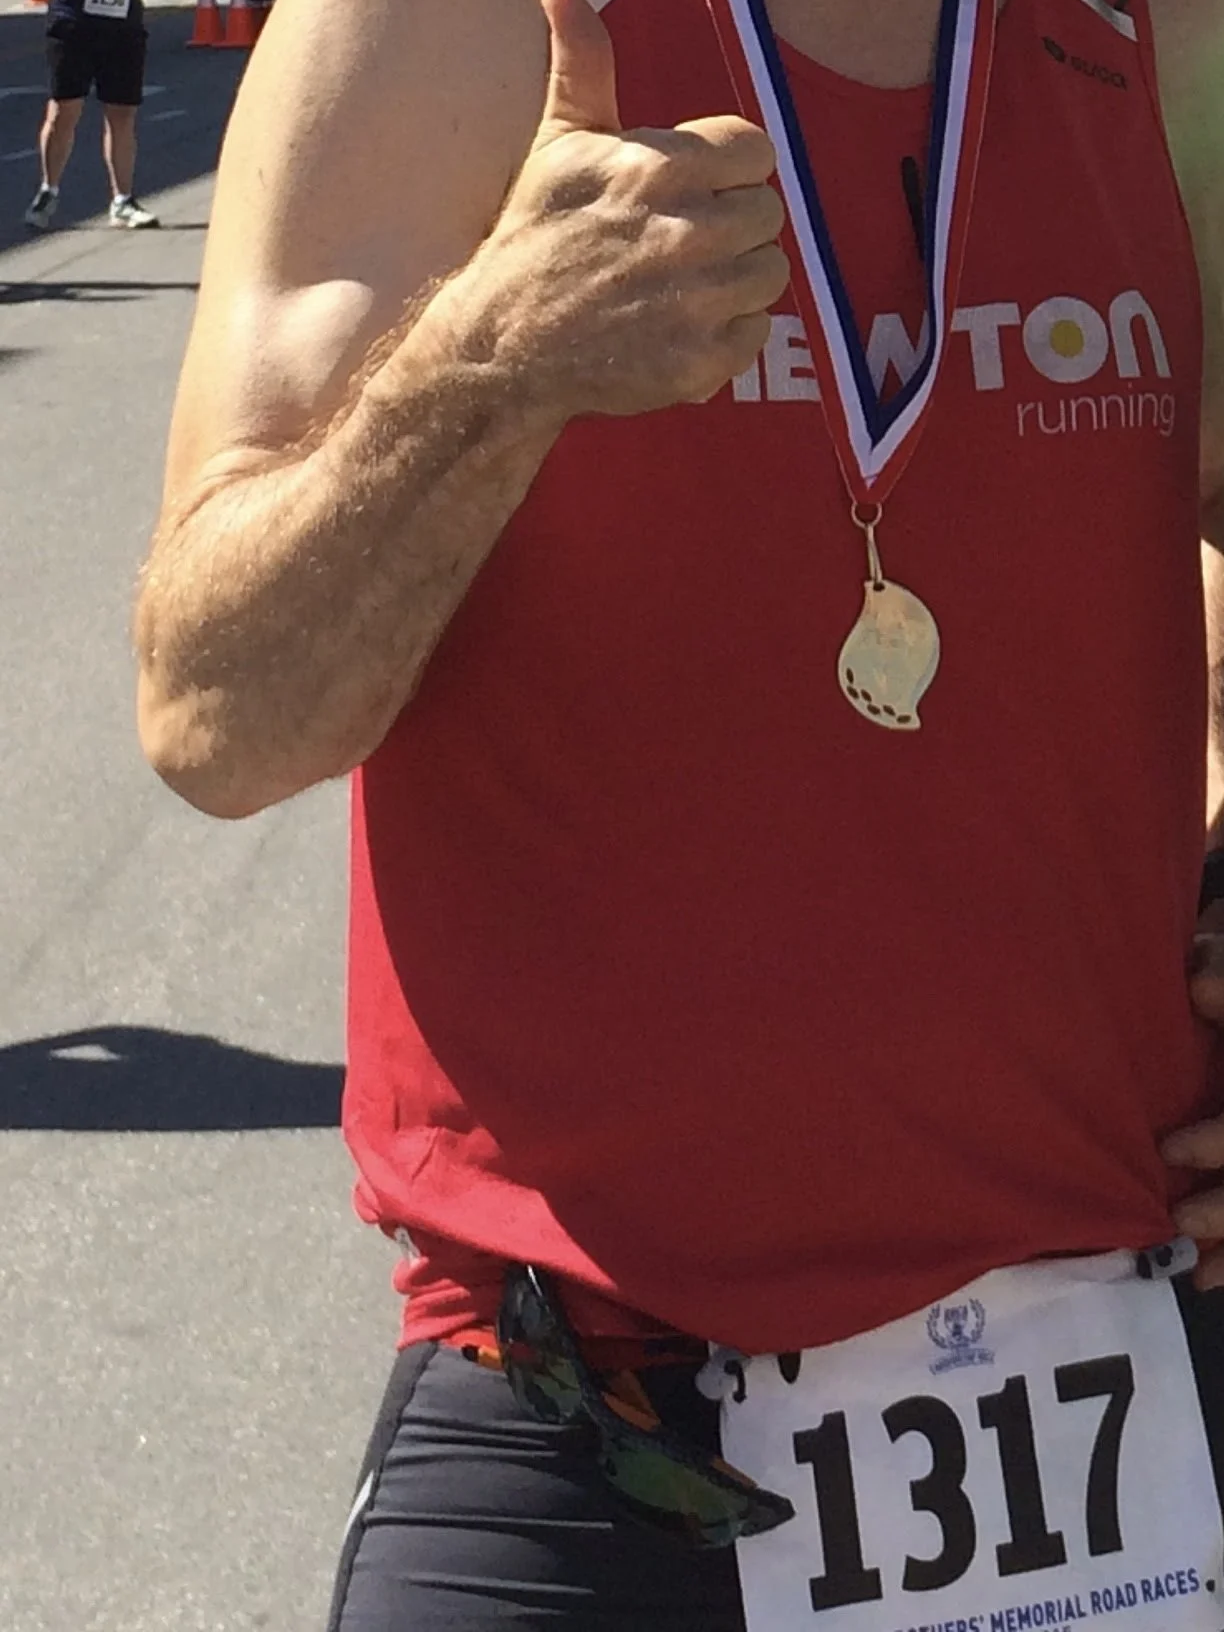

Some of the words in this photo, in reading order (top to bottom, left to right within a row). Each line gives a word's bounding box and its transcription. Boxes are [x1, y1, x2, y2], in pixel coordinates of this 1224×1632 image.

[1016, 382, 1176, 436] running
[792, 1353, 1136, 1613] 1317
[989, 1594, 1087, 1632] MEMORIAL
[1090, 1581, 1137, 1615] ROAD
[1140, 1568, 1200, 1604] RACES
